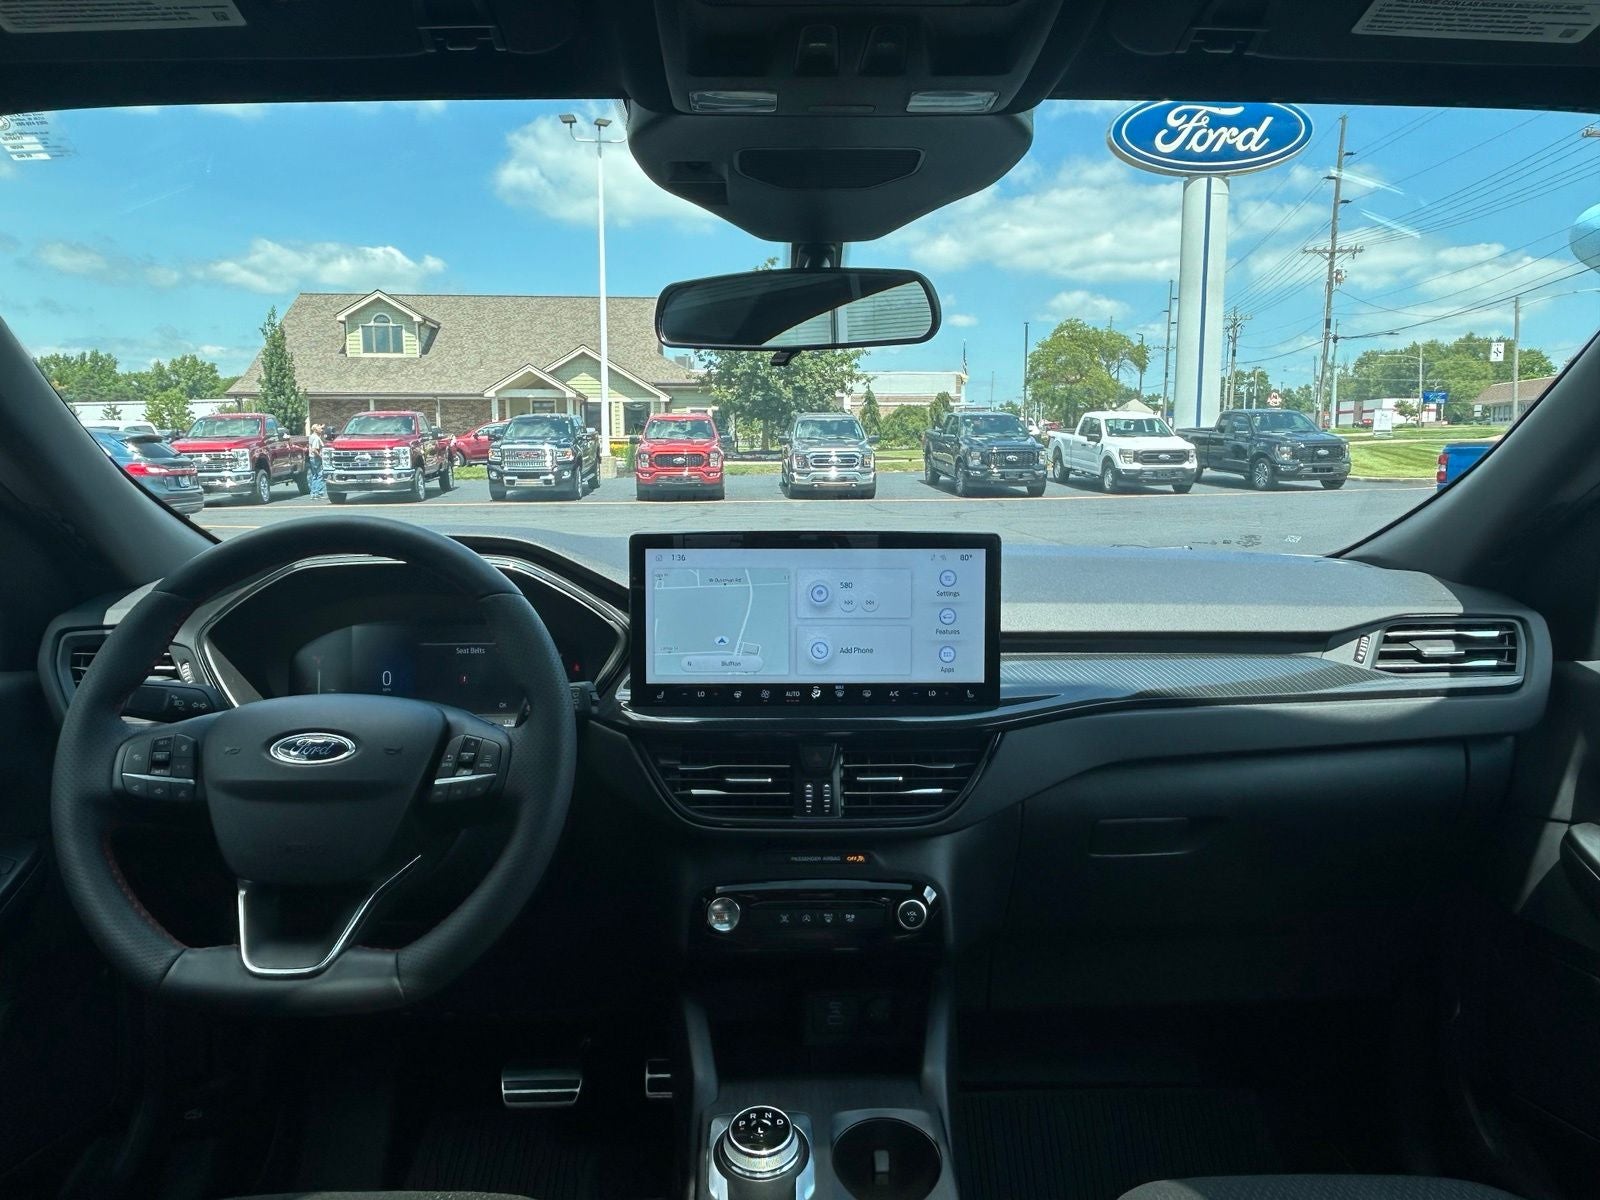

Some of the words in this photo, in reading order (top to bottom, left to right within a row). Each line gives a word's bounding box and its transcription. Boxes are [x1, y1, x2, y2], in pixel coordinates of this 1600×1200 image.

[1154, 104, 1274, 153] Ford
[671, 554, 687, 562] 1:36
[455, 647, 469, 655] Seat
[839, 646, 853, 654] Add
[853, 646, 874, 654] Phone
[382, 670, 392, 685] 0
[290, 738, 334, 756] Ford
